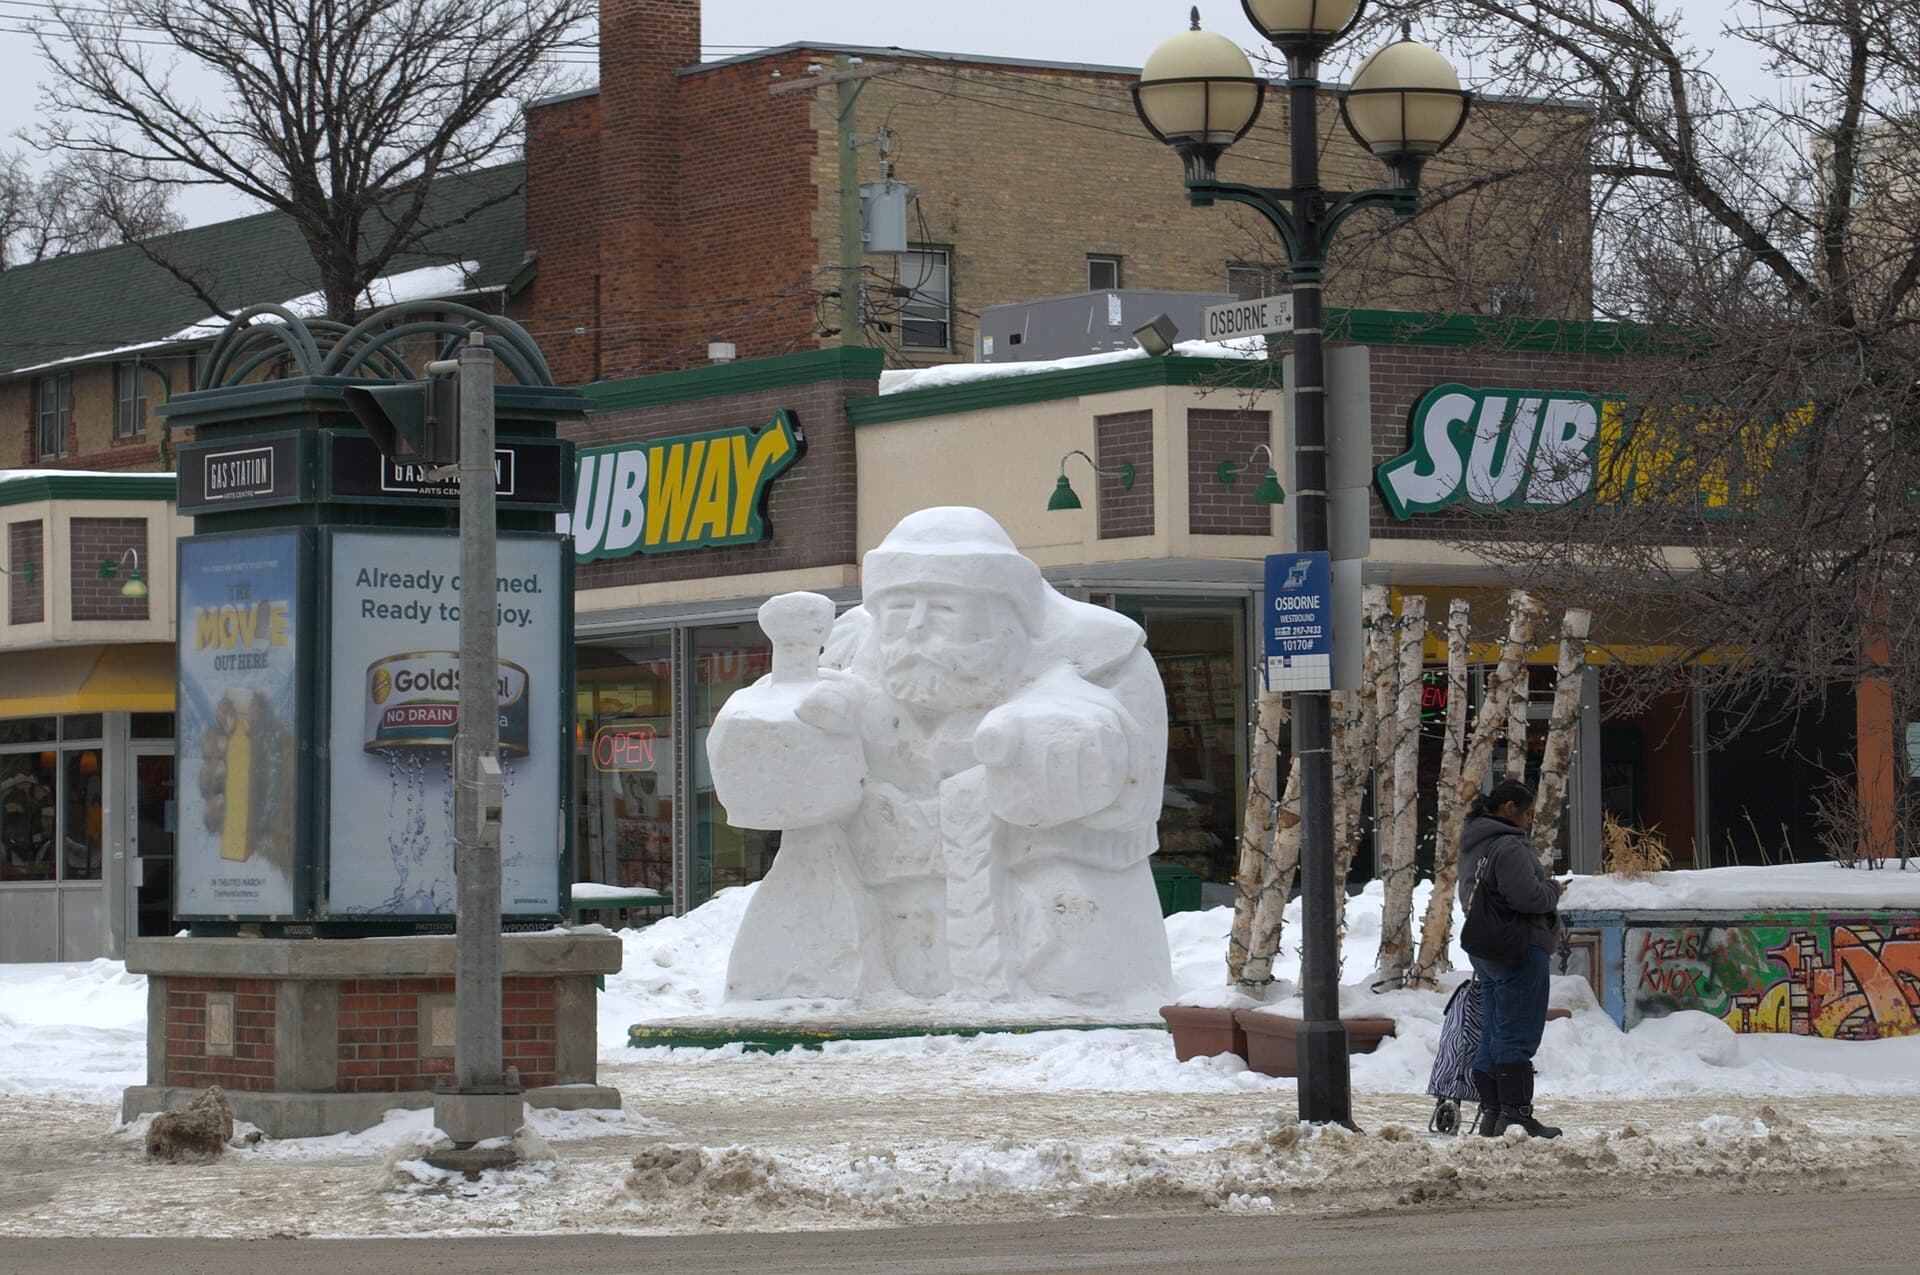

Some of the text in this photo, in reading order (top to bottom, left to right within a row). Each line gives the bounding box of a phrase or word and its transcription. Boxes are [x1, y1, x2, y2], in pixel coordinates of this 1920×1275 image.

[1210, 301, 1288, 336] OSBORNE ST
[211, 457, 267, 489] GAS STATION
[443, 488, 461, 496] CEN
[555, 418, 789, 555] UBWAY
[356, 568, 542, 593] Already oned.
[361, 600, 533, 627] Ready to joy.
[1275, 596, 1320, 610] OSBORNE
[1280, 613, 1315, 623] WESTBOUND
[1283, 640, 1314, 651] 10170#
[214, 653, 268, 671] OUT HERE
[1422, 687, 1448, 708] EN
[387, 709, 452, 723] NO DRAIN
[598, 730, 655, 766] OPEN
[1637, 931, 1700, 965] KELS
[1638, 962, 1703, 997] KNOX
